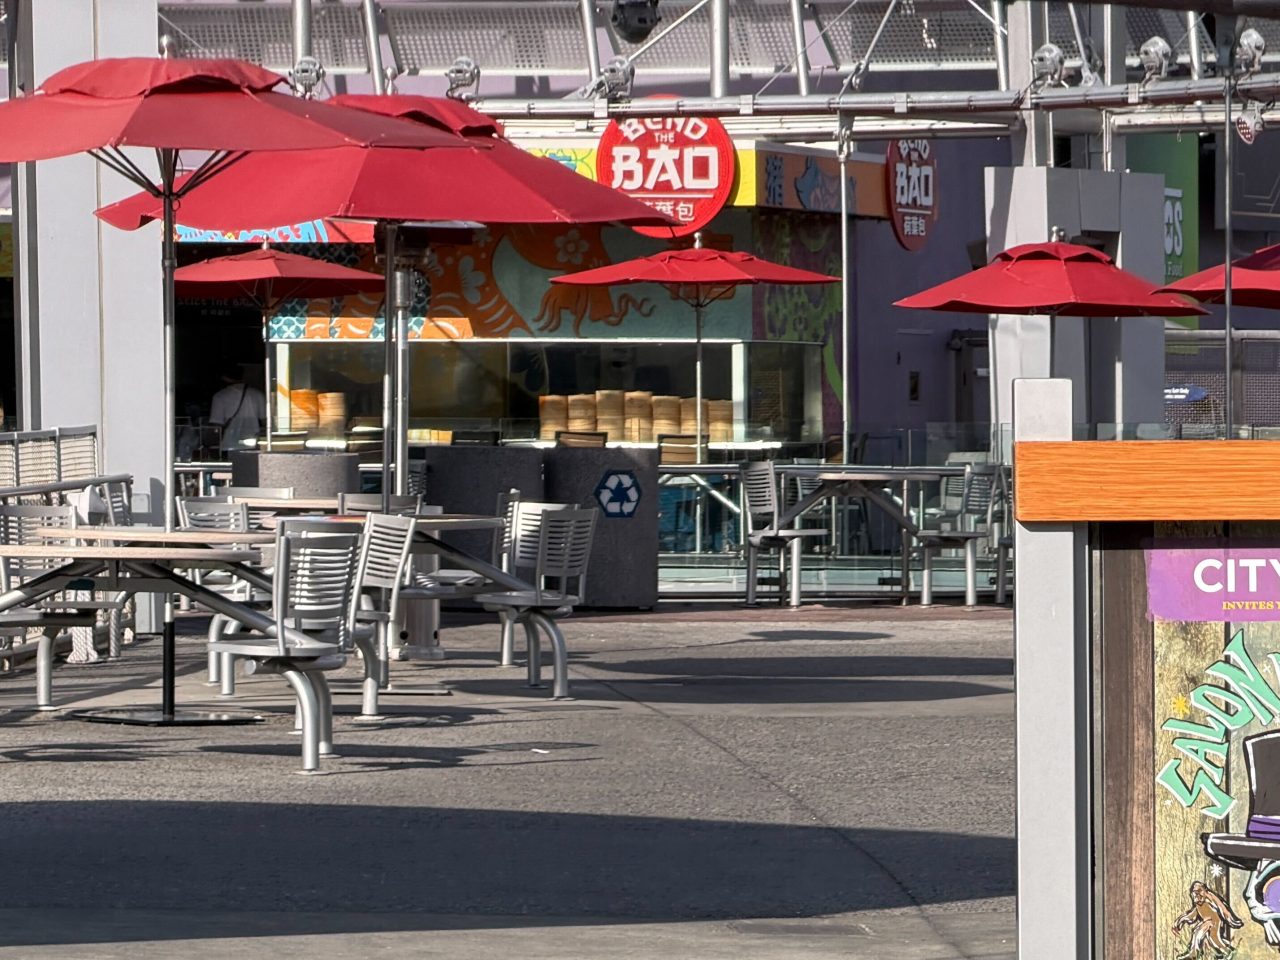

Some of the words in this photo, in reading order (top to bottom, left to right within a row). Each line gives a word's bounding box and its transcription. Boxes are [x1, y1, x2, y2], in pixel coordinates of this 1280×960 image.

[654, 132, 675, 143] THE
[611, 143, 719, 190] BAO
[895, 161, 934, 206] BAO
[1222, 600, 1275, 610] INVITES
